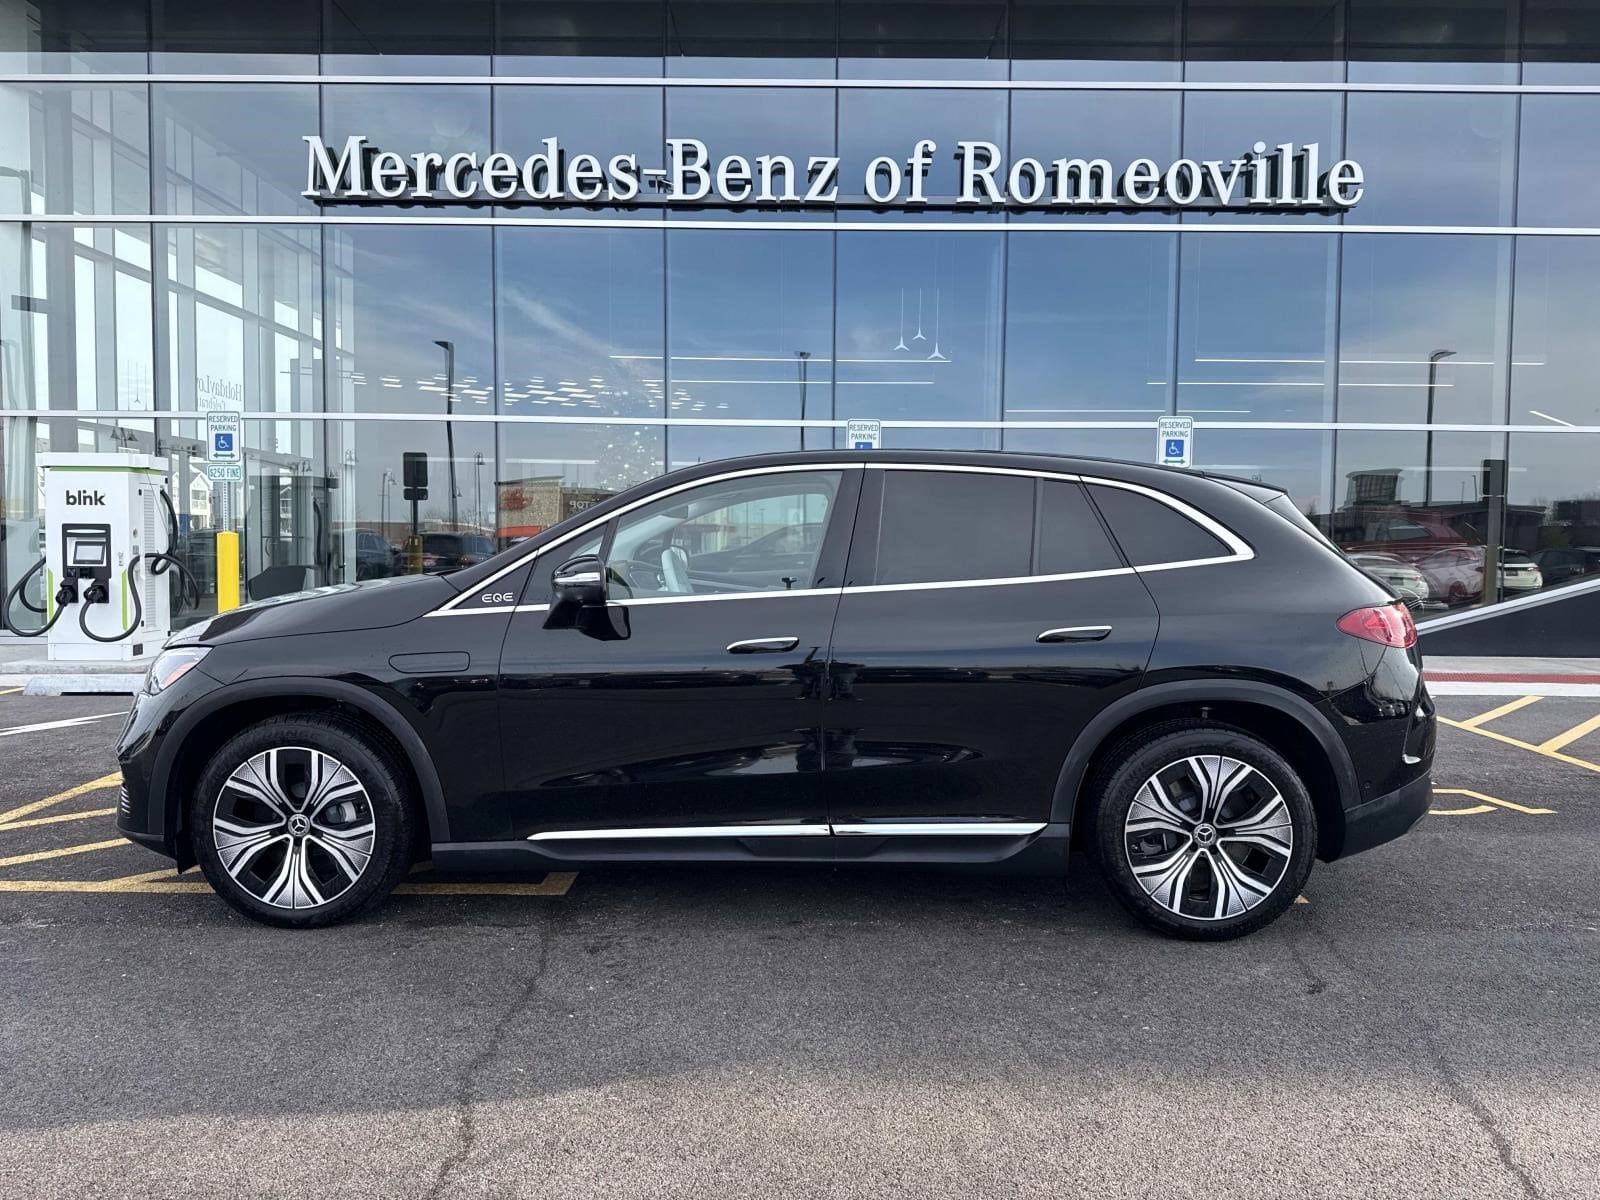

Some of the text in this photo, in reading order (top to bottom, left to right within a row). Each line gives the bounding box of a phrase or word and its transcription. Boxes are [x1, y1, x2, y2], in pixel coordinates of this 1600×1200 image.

[301, 135, 1366, 206] Mercedes-Benz of Romeoville
[208, 415, 240, 423] RESERVED
[210, 424, 237, 432] PARKING
[850, 424, 879, 432] RESERVED
[1160, 421, 1191, 429] RESERVED
[850, 432, 877, 440] PARKING
[1162, 430, 1189, 438] PARKING
[209, 467, 240, 478] $250 FINE
[65, 489, 107, 506] blink
[481, 592, 514, 603] EQE
